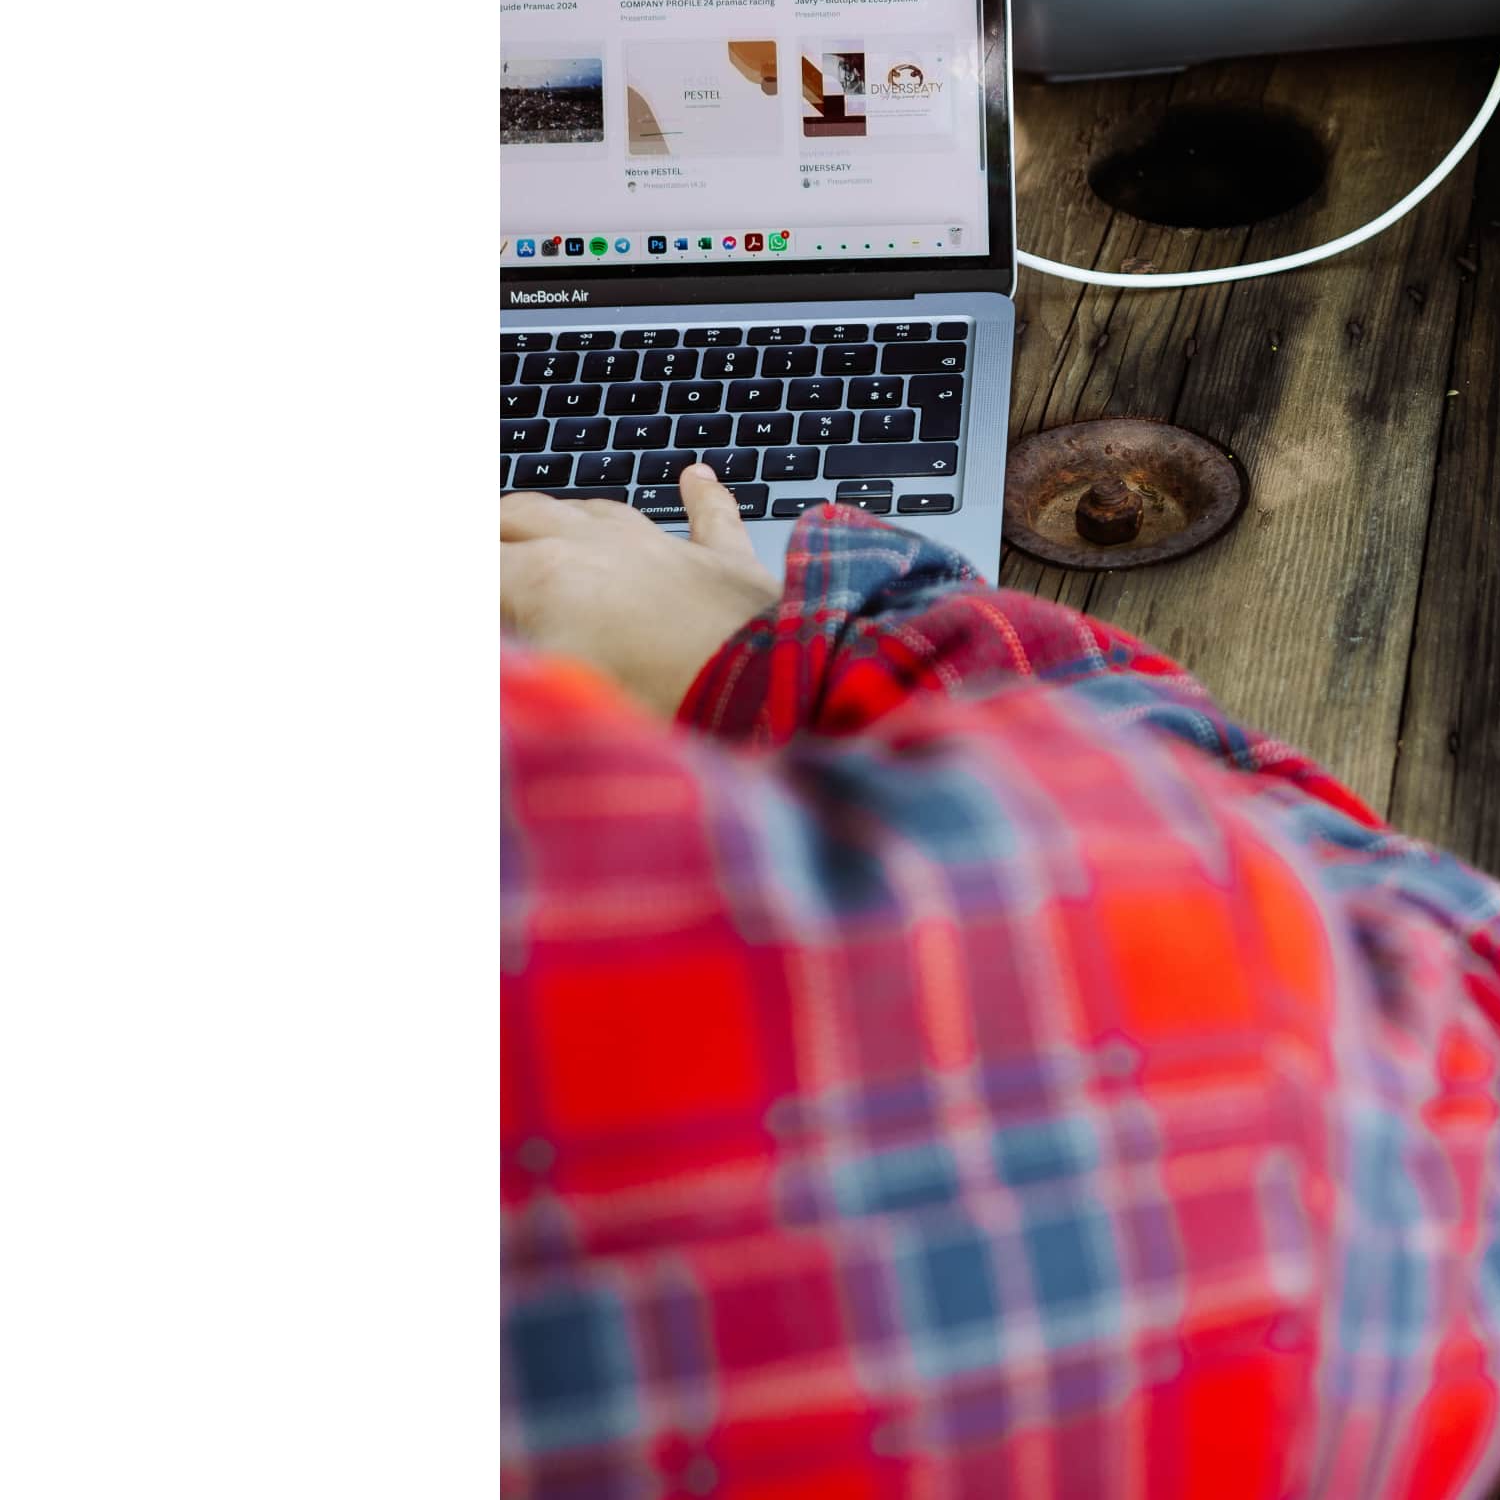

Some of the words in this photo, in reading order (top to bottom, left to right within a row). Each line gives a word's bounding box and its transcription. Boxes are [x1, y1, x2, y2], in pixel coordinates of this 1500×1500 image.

[523, 3, 555, 11] Pramac
[556, 1, 577, 10] 2024
[620, 0, 664, 8] COMPANY
[666, 0, 703, 8] PROFILE
[704, 0, 714, 7] 24
[716, 0, 748, 9] pramac
[871, 82, 944, 95] DIVERSEATY
[684, 90, 721, 101] PESTEL
[625, 168, 649, 177] Notre
[650, 167, 683, 176] PESTEL
[800, 163, 852, 173] DIVERSEATY
[569, 241, 581, 251] Lr
[651, 240, 664, 250] Ps
[510, 290, 569, 304] MacBook
[571, 290, 590, 303] Air
[547, 357, 556, 365] 7
[606, 356, 616, 365] 8
[666, 354, 676, 362] 9
[663, 366, 673, 376] ç
[567, 395, 579, 405] U
[688, 391, 700, 402] O
[749, 390, 760, 400] P
[507, 396, 518, 406] Y
[636, 427, 648, 437] K
[698, 425, 708, 435] L
[757, 423, 771, 434] M
[513, 430, 526, 441] H
[575, 429, 586, 439] J
[601, 456, 612, 468] ?
[536, 464, 549, 475] N
[639, 505, 688, 515] comman
